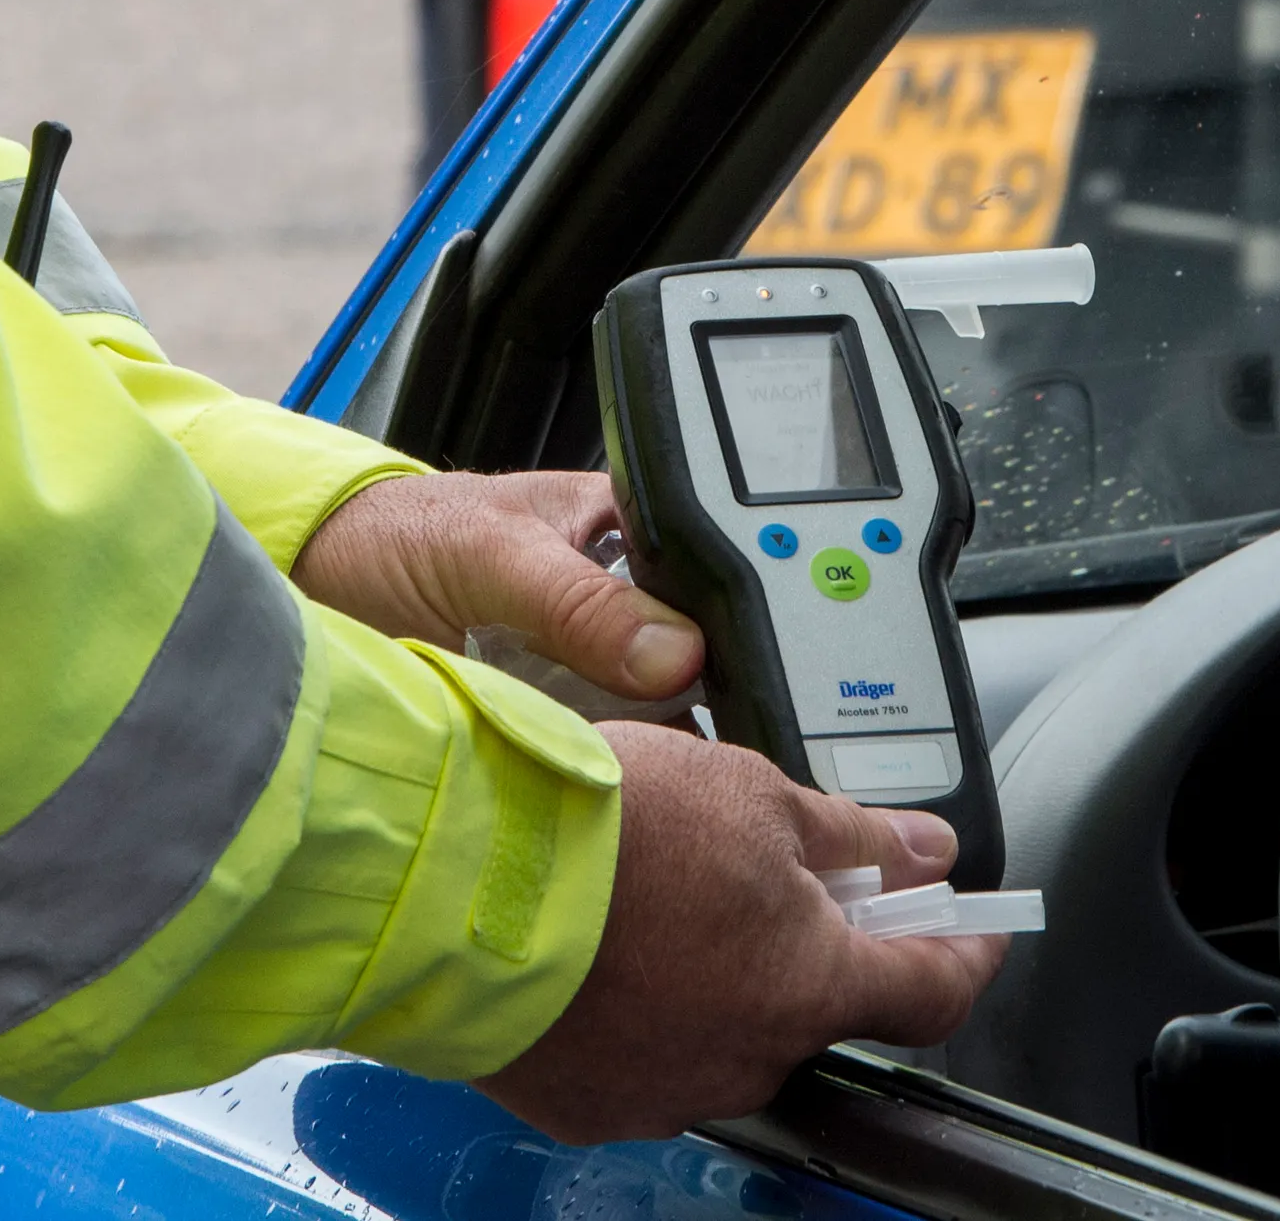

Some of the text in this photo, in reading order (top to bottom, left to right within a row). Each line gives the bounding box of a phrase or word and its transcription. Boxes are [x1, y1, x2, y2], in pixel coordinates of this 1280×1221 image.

[825, 565, 855, 582] OK
[839, 680, 895, 700] Dräger
[837, 705, 909, 717] Alcotest 7510
